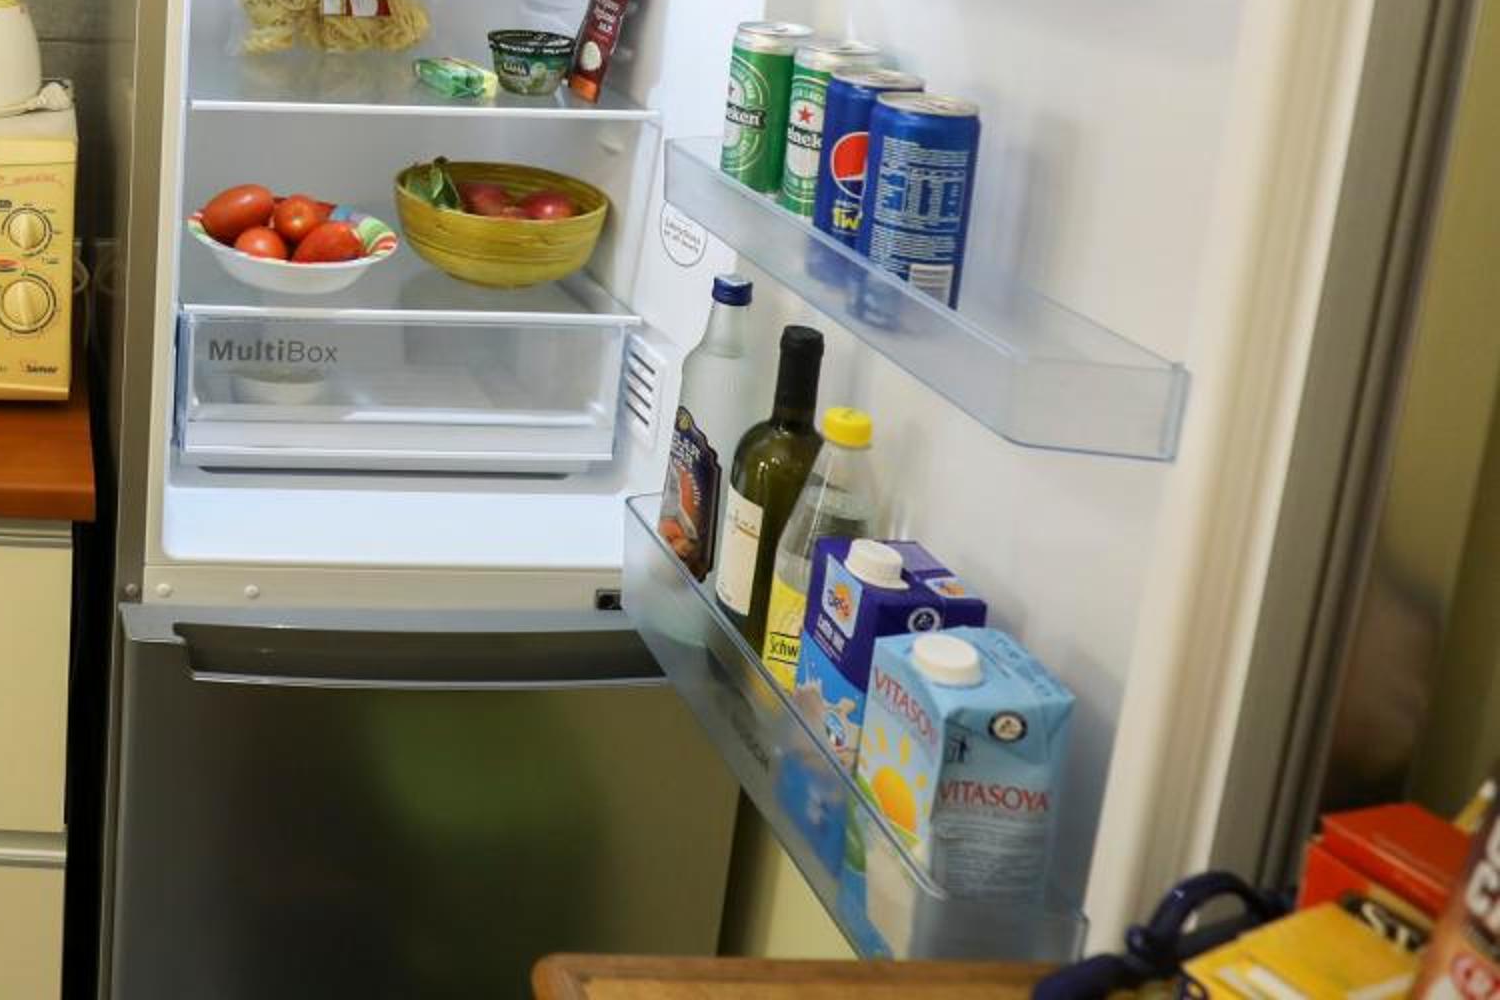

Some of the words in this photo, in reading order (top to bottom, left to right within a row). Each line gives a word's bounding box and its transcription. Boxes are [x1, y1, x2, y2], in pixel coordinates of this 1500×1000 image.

[208, 338, 339, 363] MultiBox
[769, 635, 798, 658] Schw
[938, 780, 1049, 812] VITASOYA
